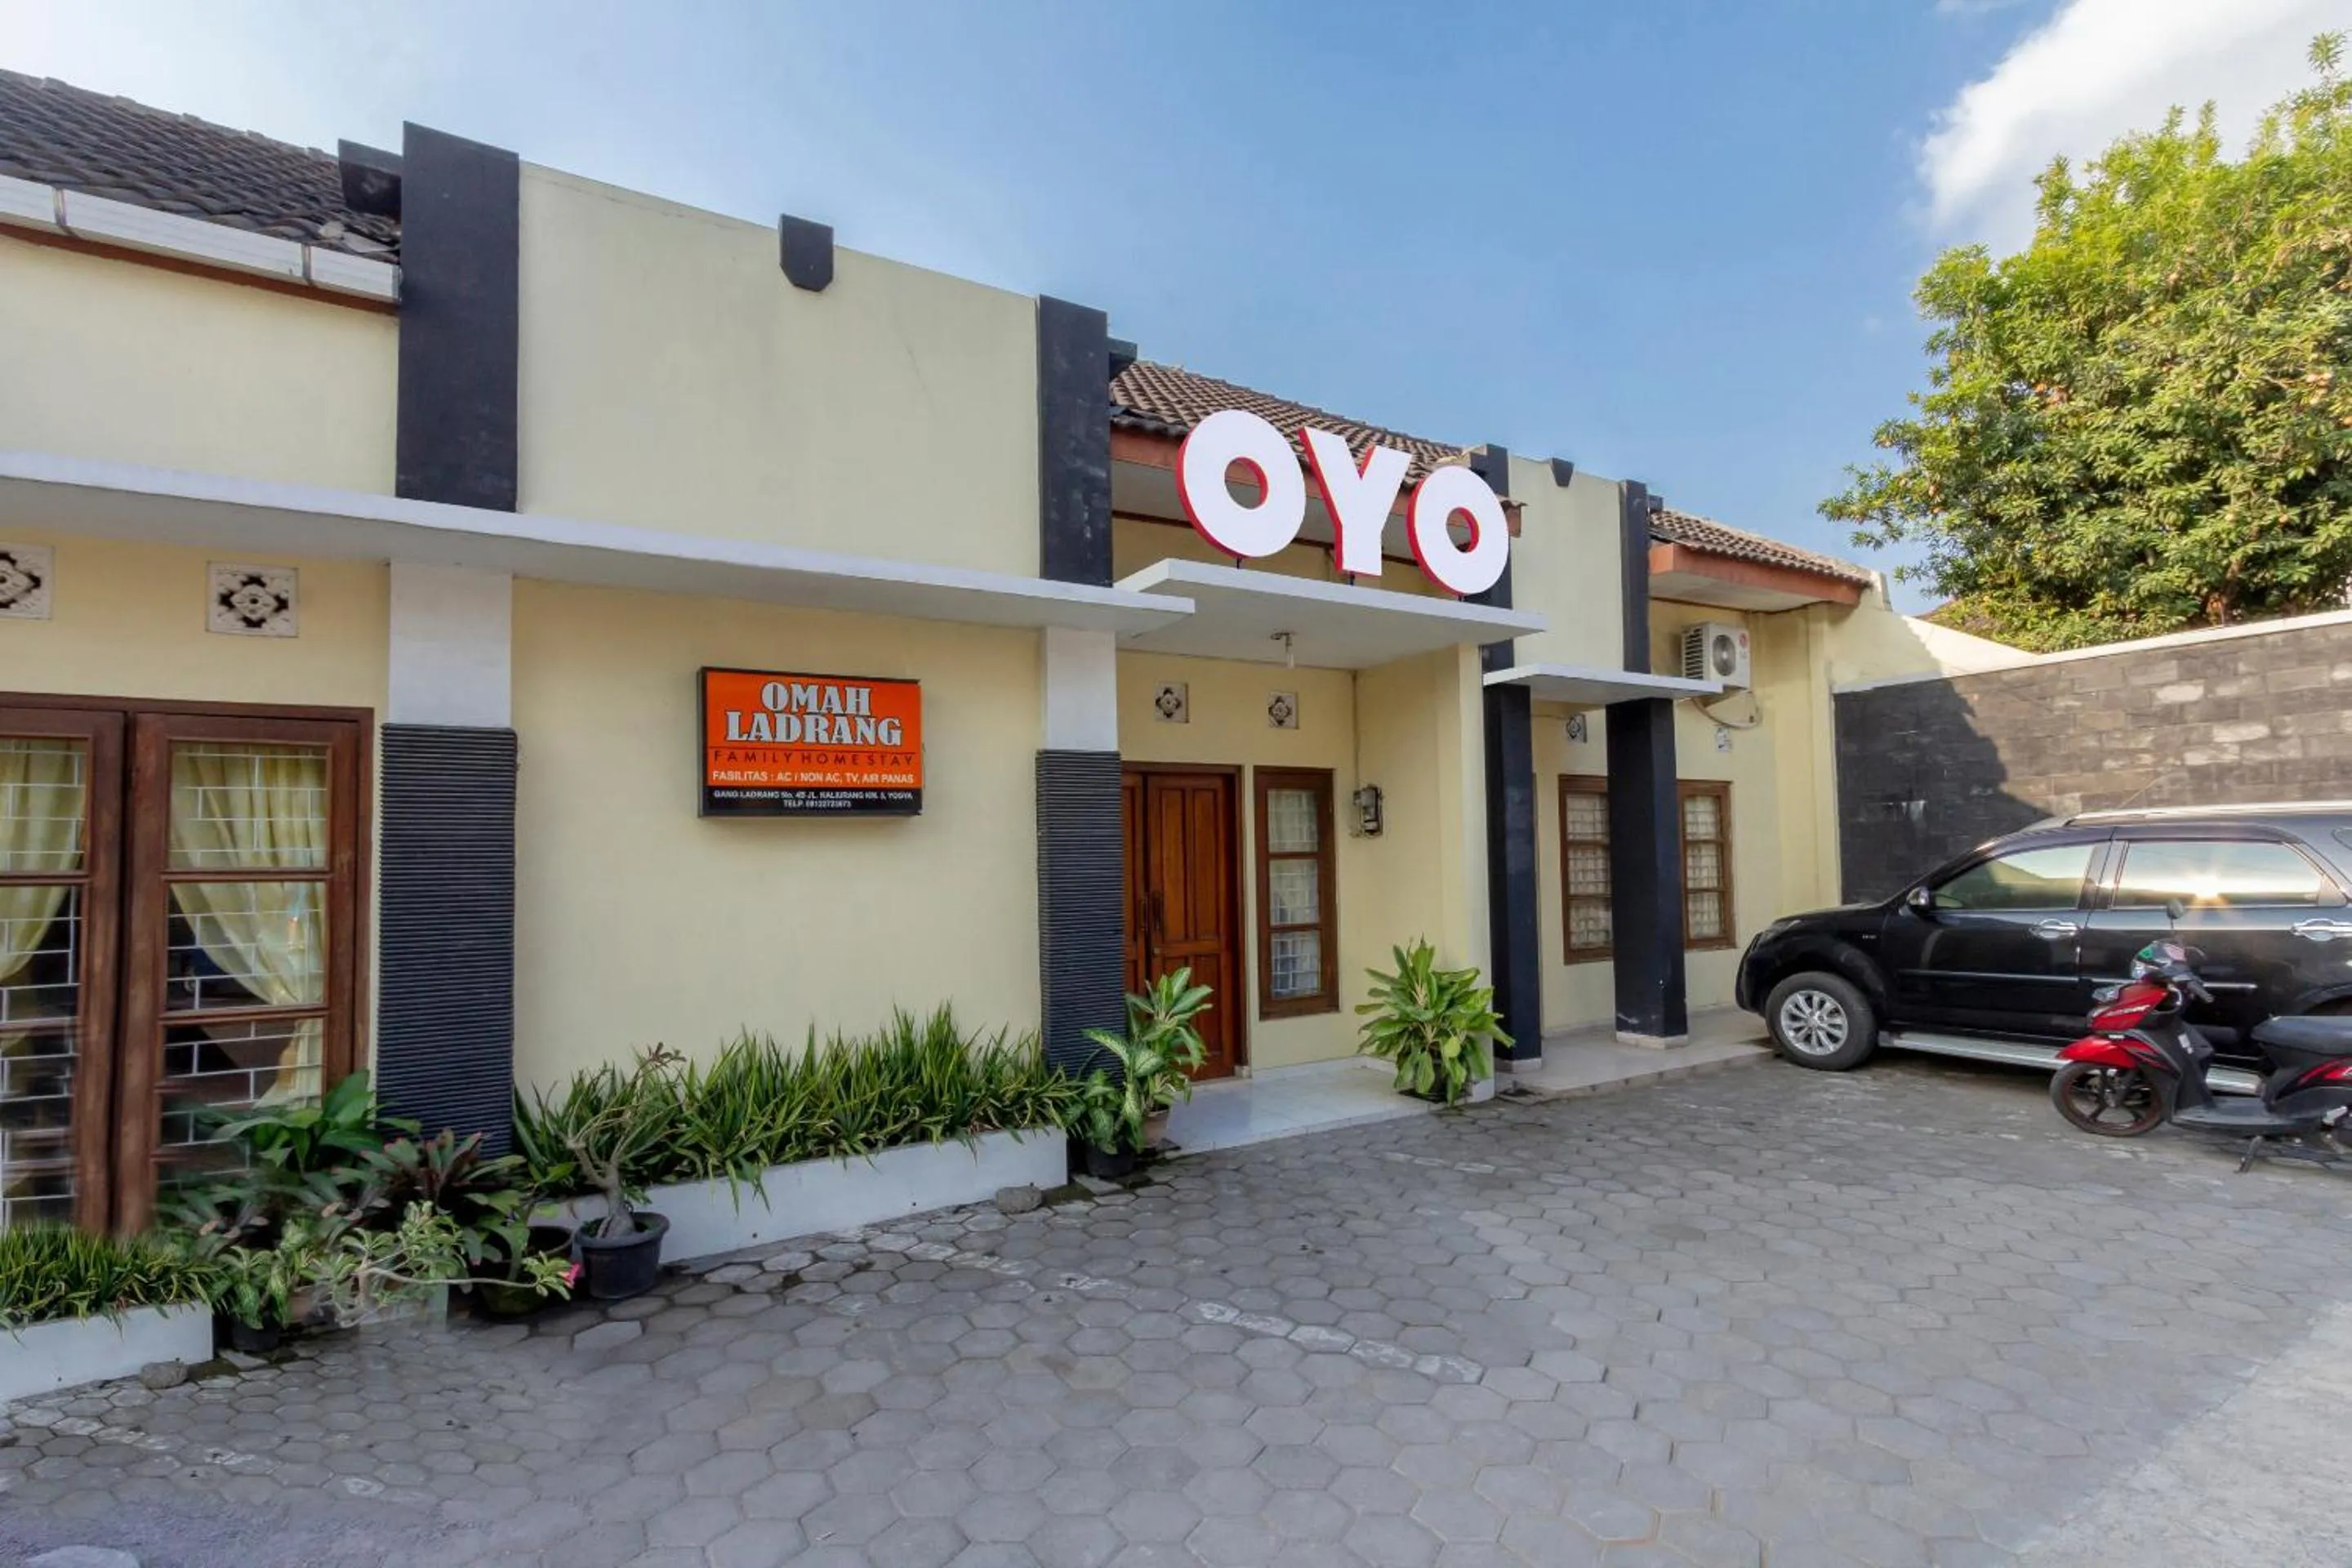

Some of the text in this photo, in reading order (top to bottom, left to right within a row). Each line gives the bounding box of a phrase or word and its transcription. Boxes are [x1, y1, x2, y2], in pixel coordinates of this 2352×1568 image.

[1176, 409, 1509, 596] OYO
[760, 680, 872, 716] OMAH
[724, 710, 902, 746] LADRANG
[714, 750, 792, 764] FAMILY
[712, 770, 768, 782] FASILITAS
[777, 772, 792, 782] AC
[800, 772, 823, 782] NON
[862, 773, 880, 783] AIR
[880, 773, 915, 784] PANAS
[740, 791, 780, 799] LADRANG
